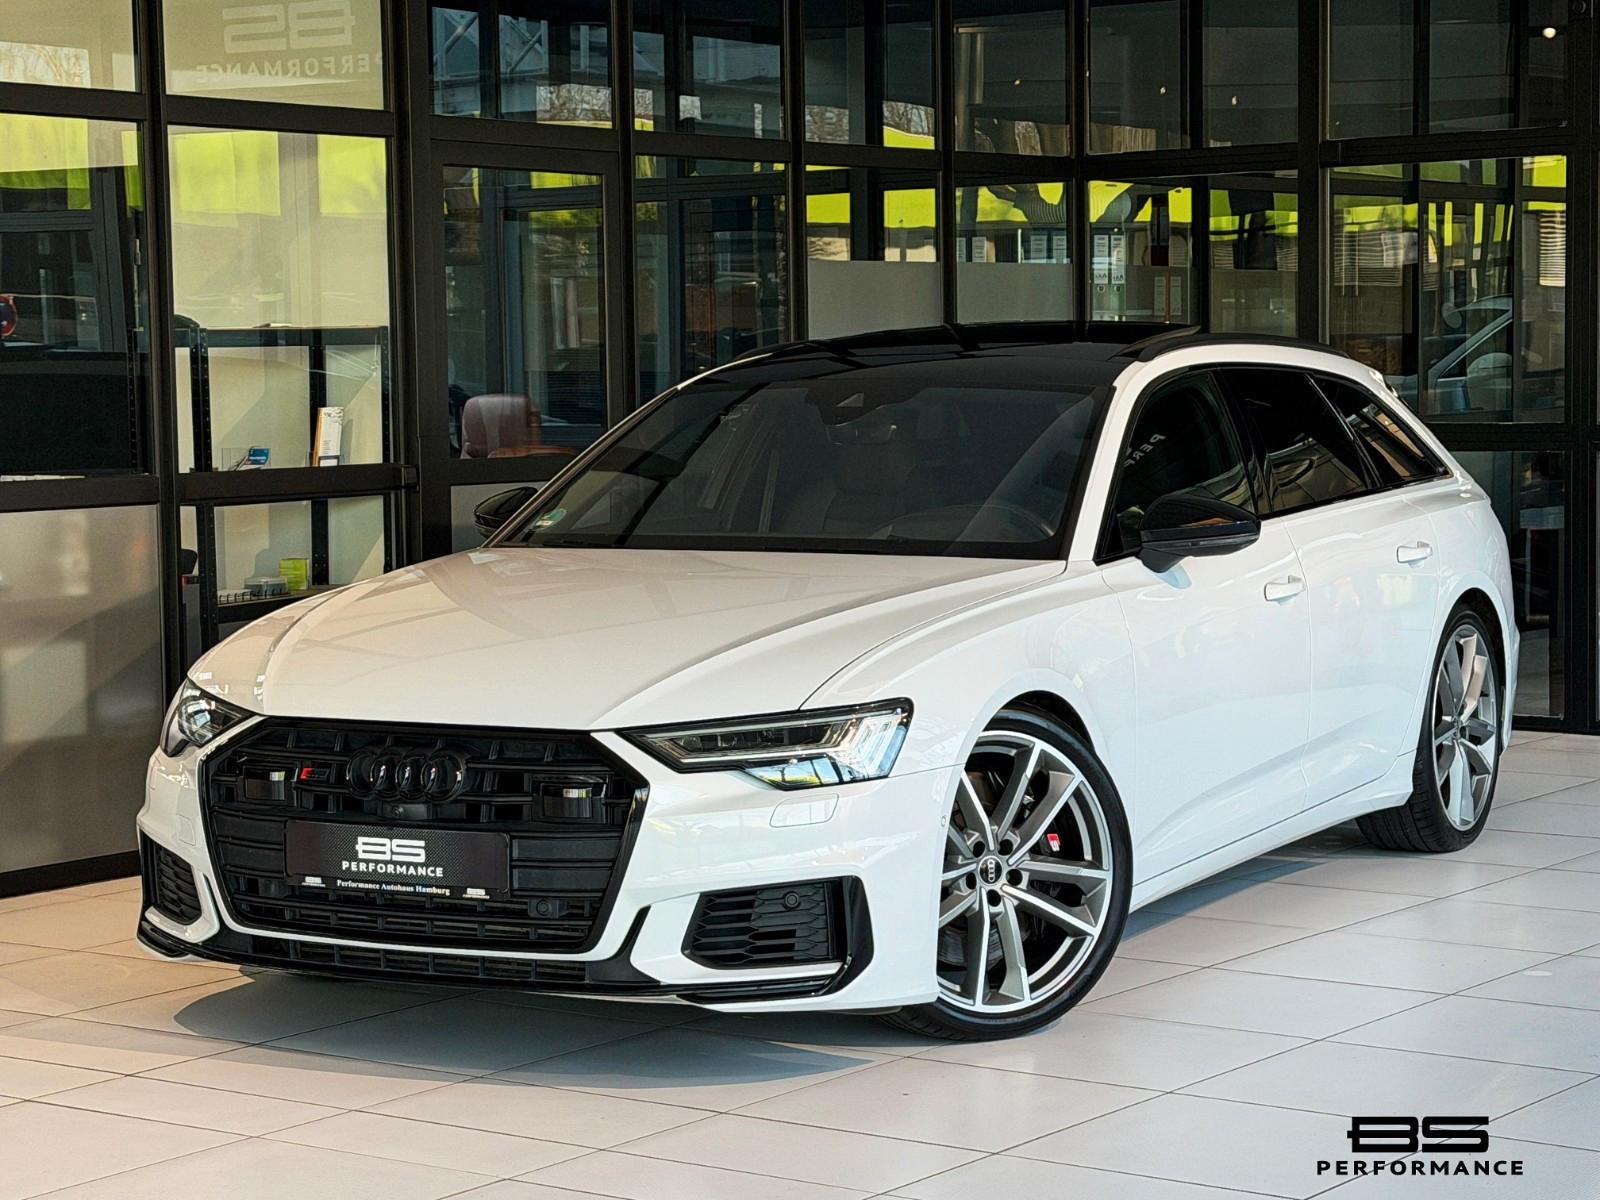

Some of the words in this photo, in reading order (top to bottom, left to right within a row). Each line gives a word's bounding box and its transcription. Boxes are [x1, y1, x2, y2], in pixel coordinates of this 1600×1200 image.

[355, 836, 426, 863] BS
[341, 860, 444, 878] PERFORMANCE
[336, 879, 380, 891] Performance
[381, 882, 414, 894] Autohaus
[415, 884, 451, 896] Hamburg
